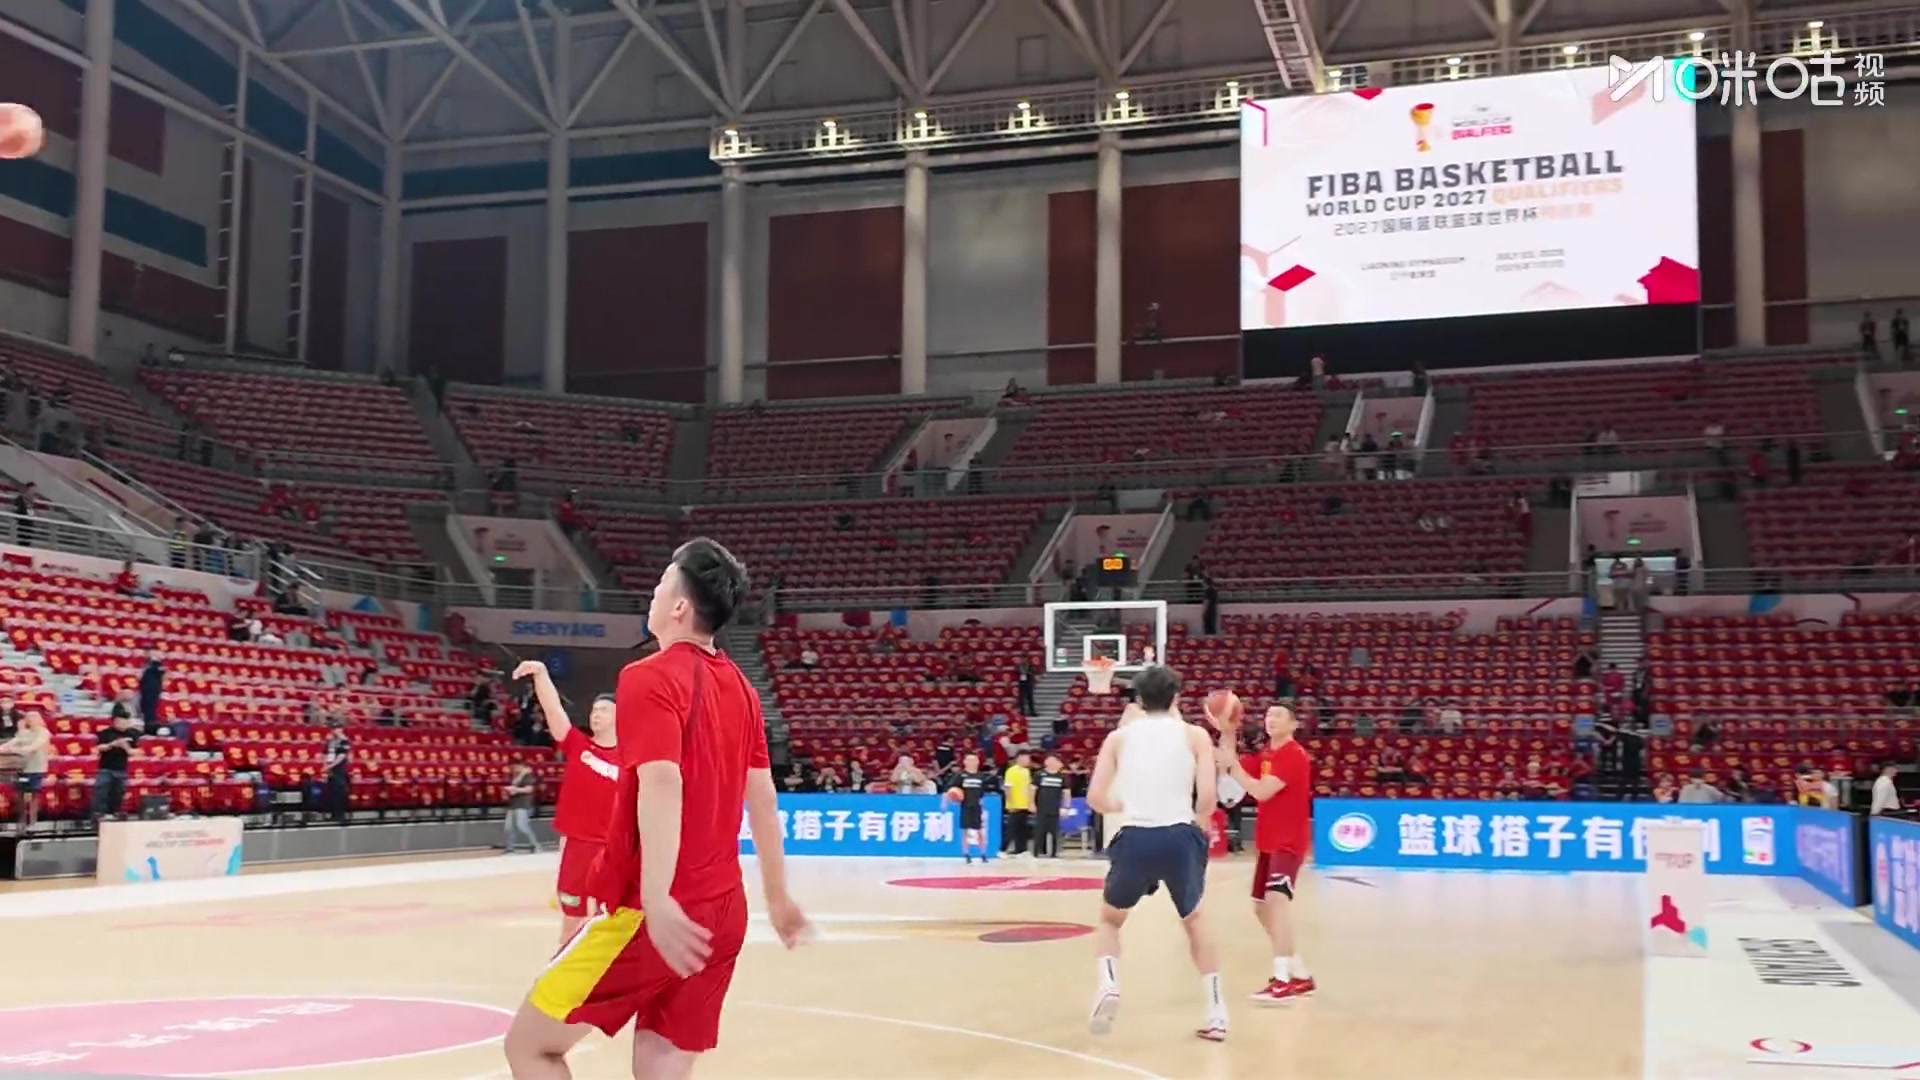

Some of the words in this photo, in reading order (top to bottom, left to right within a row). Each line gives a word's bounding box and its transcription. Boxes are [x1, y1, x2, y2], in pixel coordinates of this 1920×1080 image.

[1307, 170, 1383, 199] FIBA
[1394, 150, 1624, 192] BASKETBALL
[1306, 200, 1377, 217] WORLD
[1384, 195, 1426, 211] CUP
[1433, 189, 1487, 208] 2027
[512, 620, 606, 638] SHENYANG
[738, 810, 954, 842] 搭子有伊利
